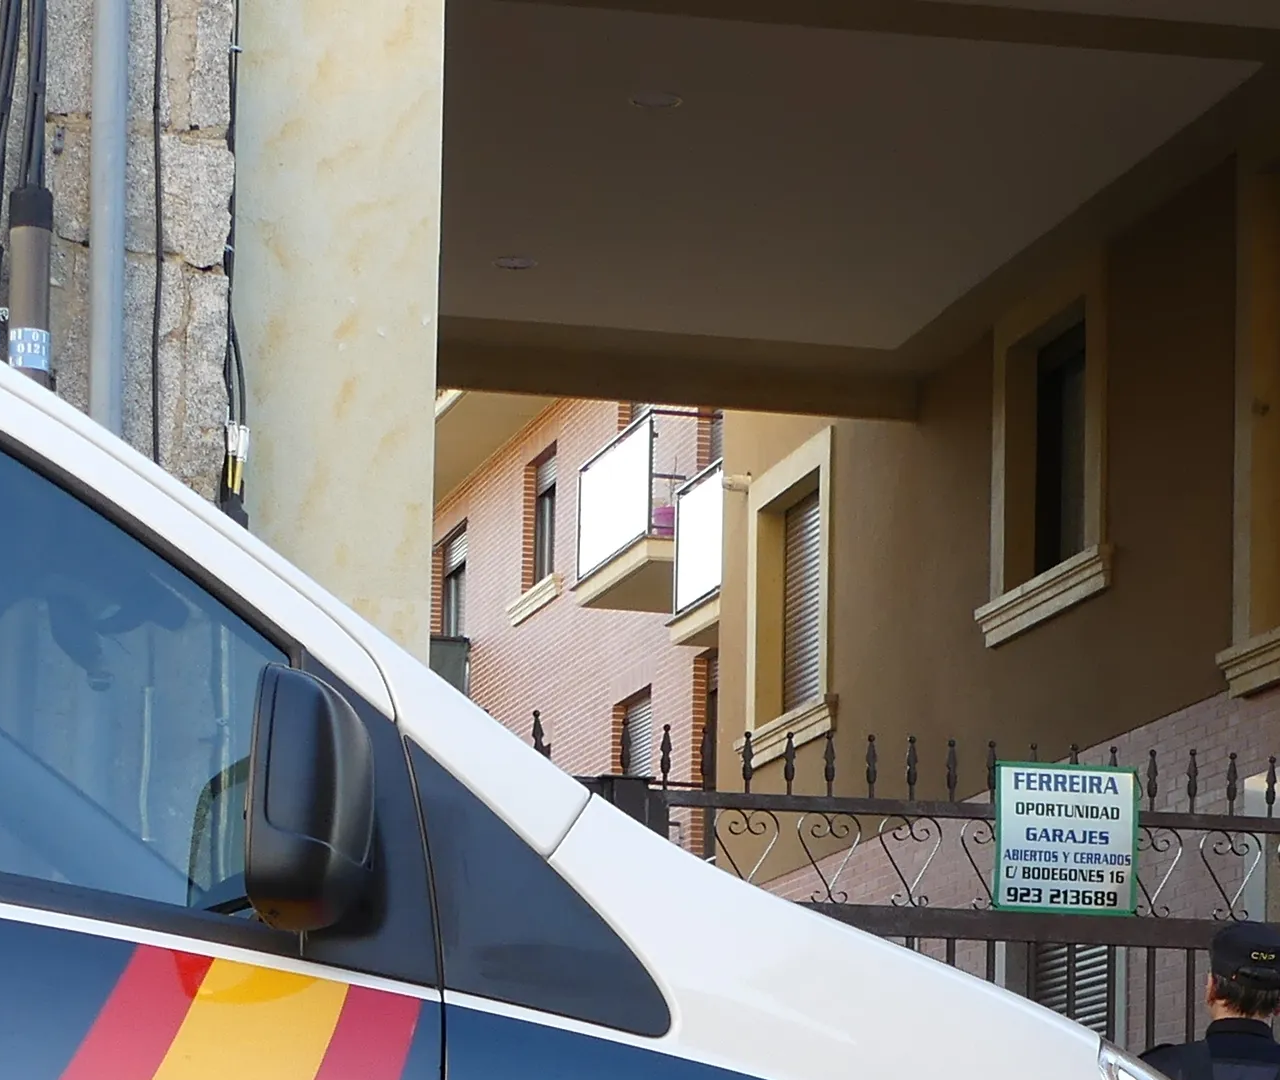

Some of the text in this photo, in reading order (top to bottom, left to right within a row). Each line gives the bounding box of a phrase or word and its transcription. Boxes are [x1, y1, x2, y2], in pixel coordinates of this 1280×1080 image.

[1013, 772, 1119, 795] FERREIRA
[1015, 801, 1120, 820] OPORTUNIDAD
[1025, 827, 1110, 845] GARAJES
[1003, 848, 1132, 866] ABIERTOS Y CERRADOS
[1005, 865, 1125, 884] C/ BODEGONES 16
[1006, 887, 1118, 907] 923 213689
